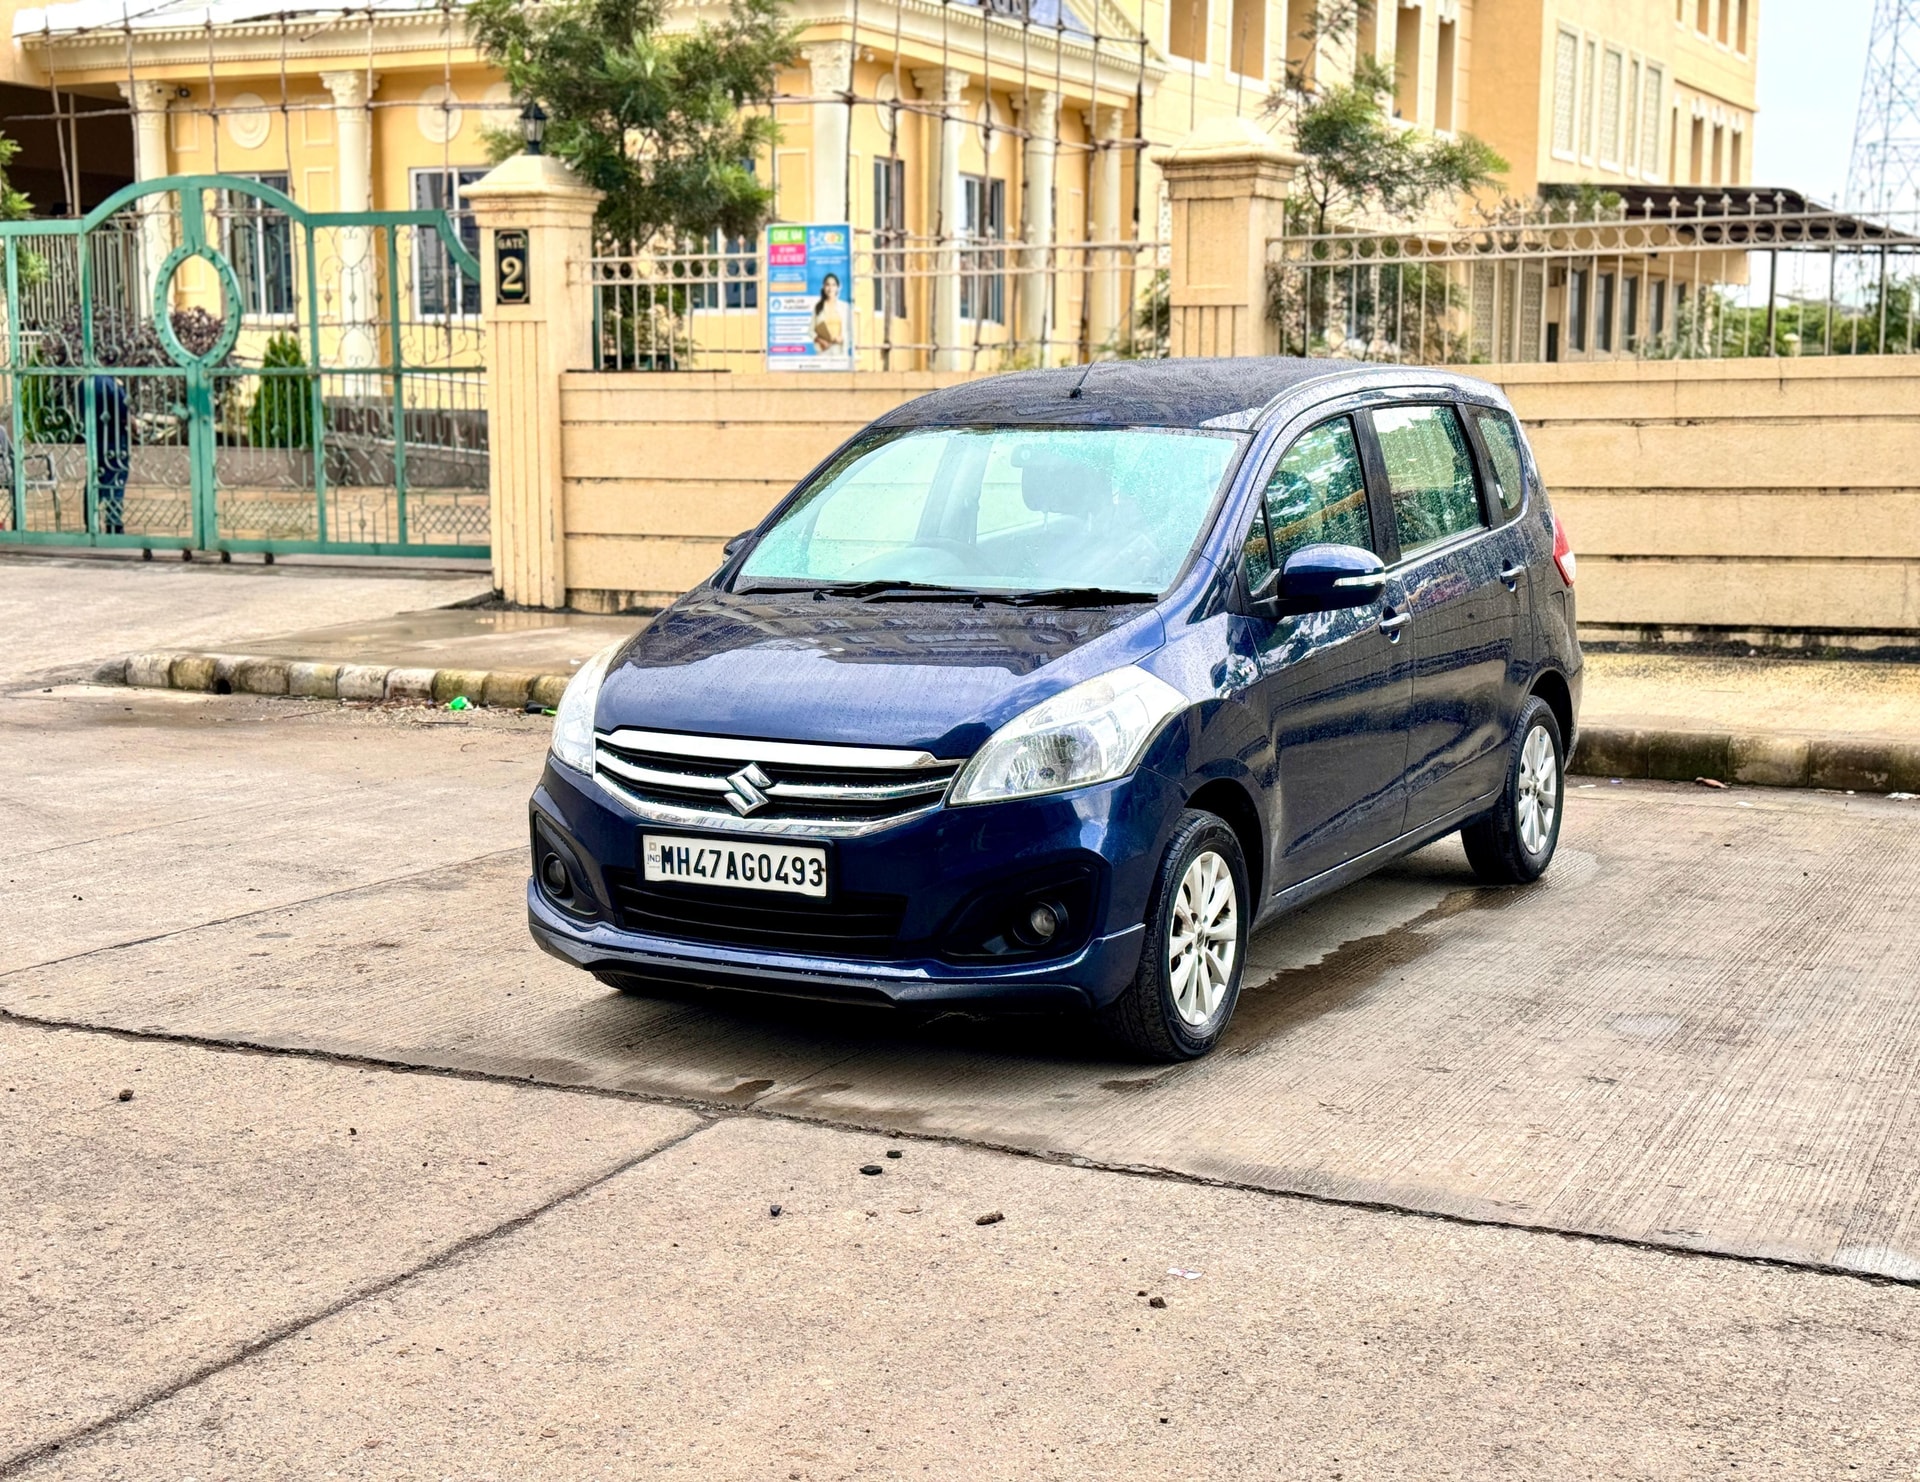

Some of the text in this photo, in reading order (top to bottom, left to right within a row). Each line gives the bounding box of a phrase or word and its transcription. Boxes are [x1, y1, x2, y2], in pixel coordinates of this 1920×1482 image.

[498, 238, 525, 250] GATE
[501, 256, 524, 292] 2
[647, 854, 661, 863] IND
[661, 845, 823, 887] MH47AG0493
